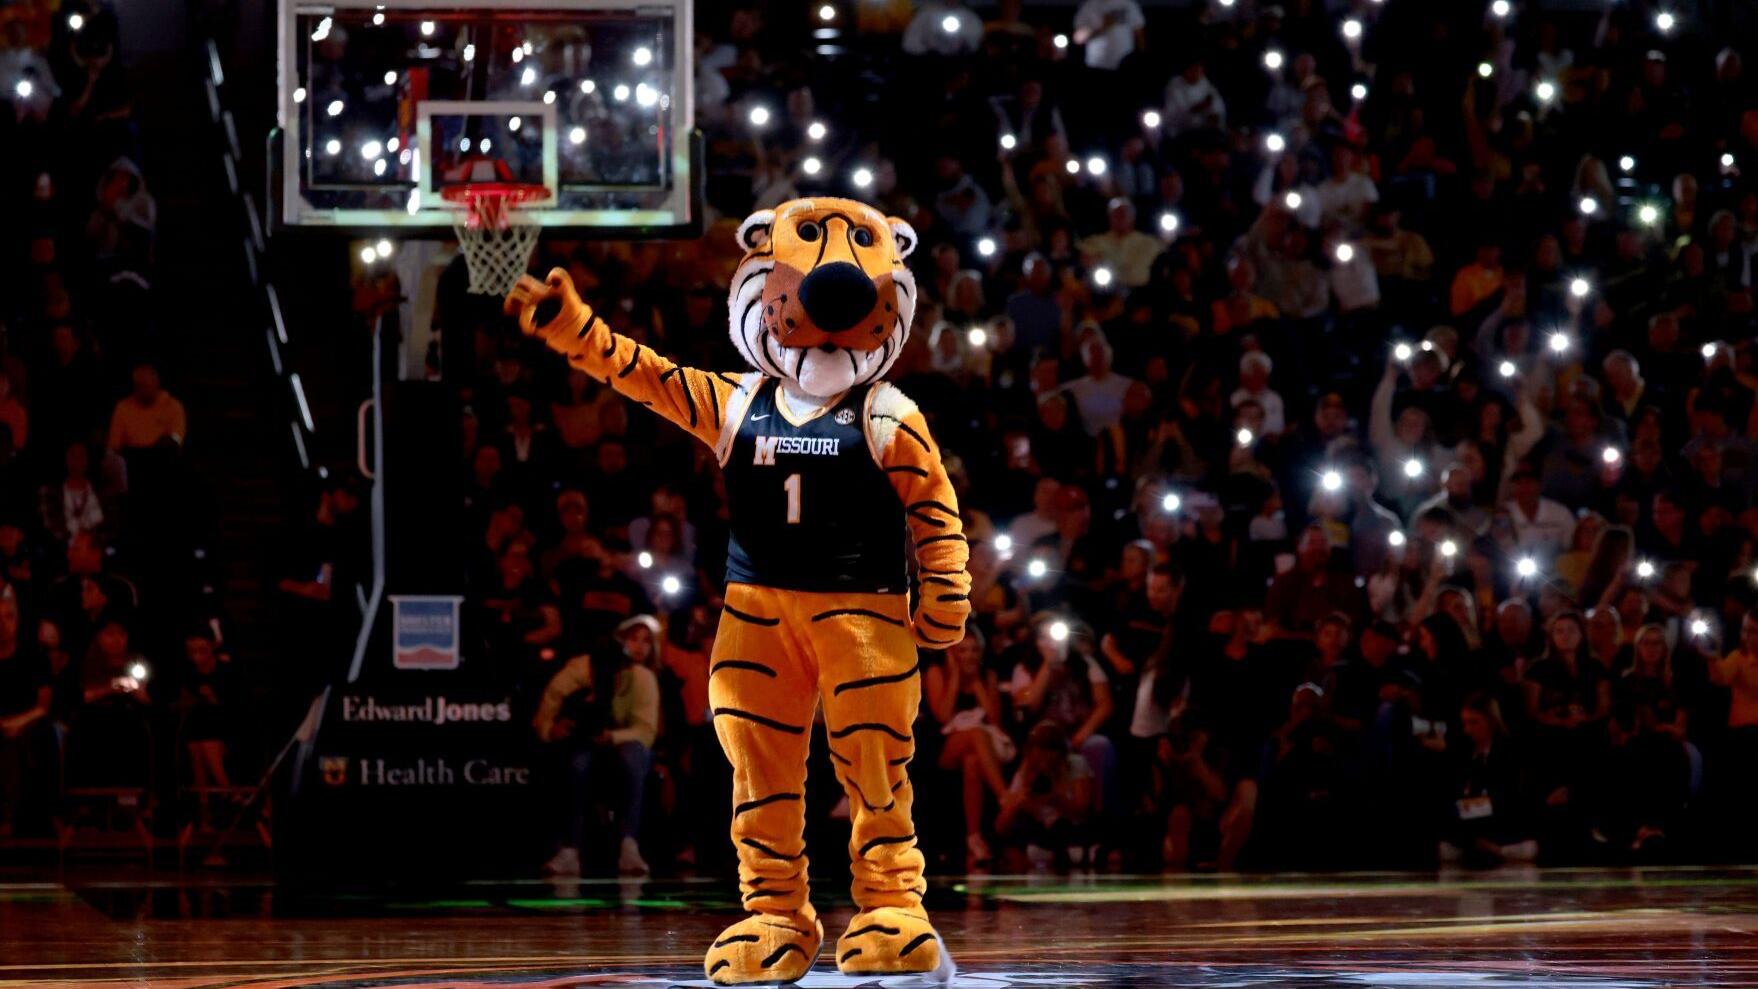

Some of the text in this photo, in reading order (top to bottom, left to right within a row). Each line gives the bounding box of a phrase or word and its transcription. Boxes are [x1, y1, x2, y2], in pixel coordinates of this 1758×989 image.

[752, 436, 839, 466] MISSOURI
[783, 473, 803, 524] 1
[342, 696, 511, 726] Edward Jones
[360, 757, 454, 784] Health
[463, 758, 530, 784] Care
